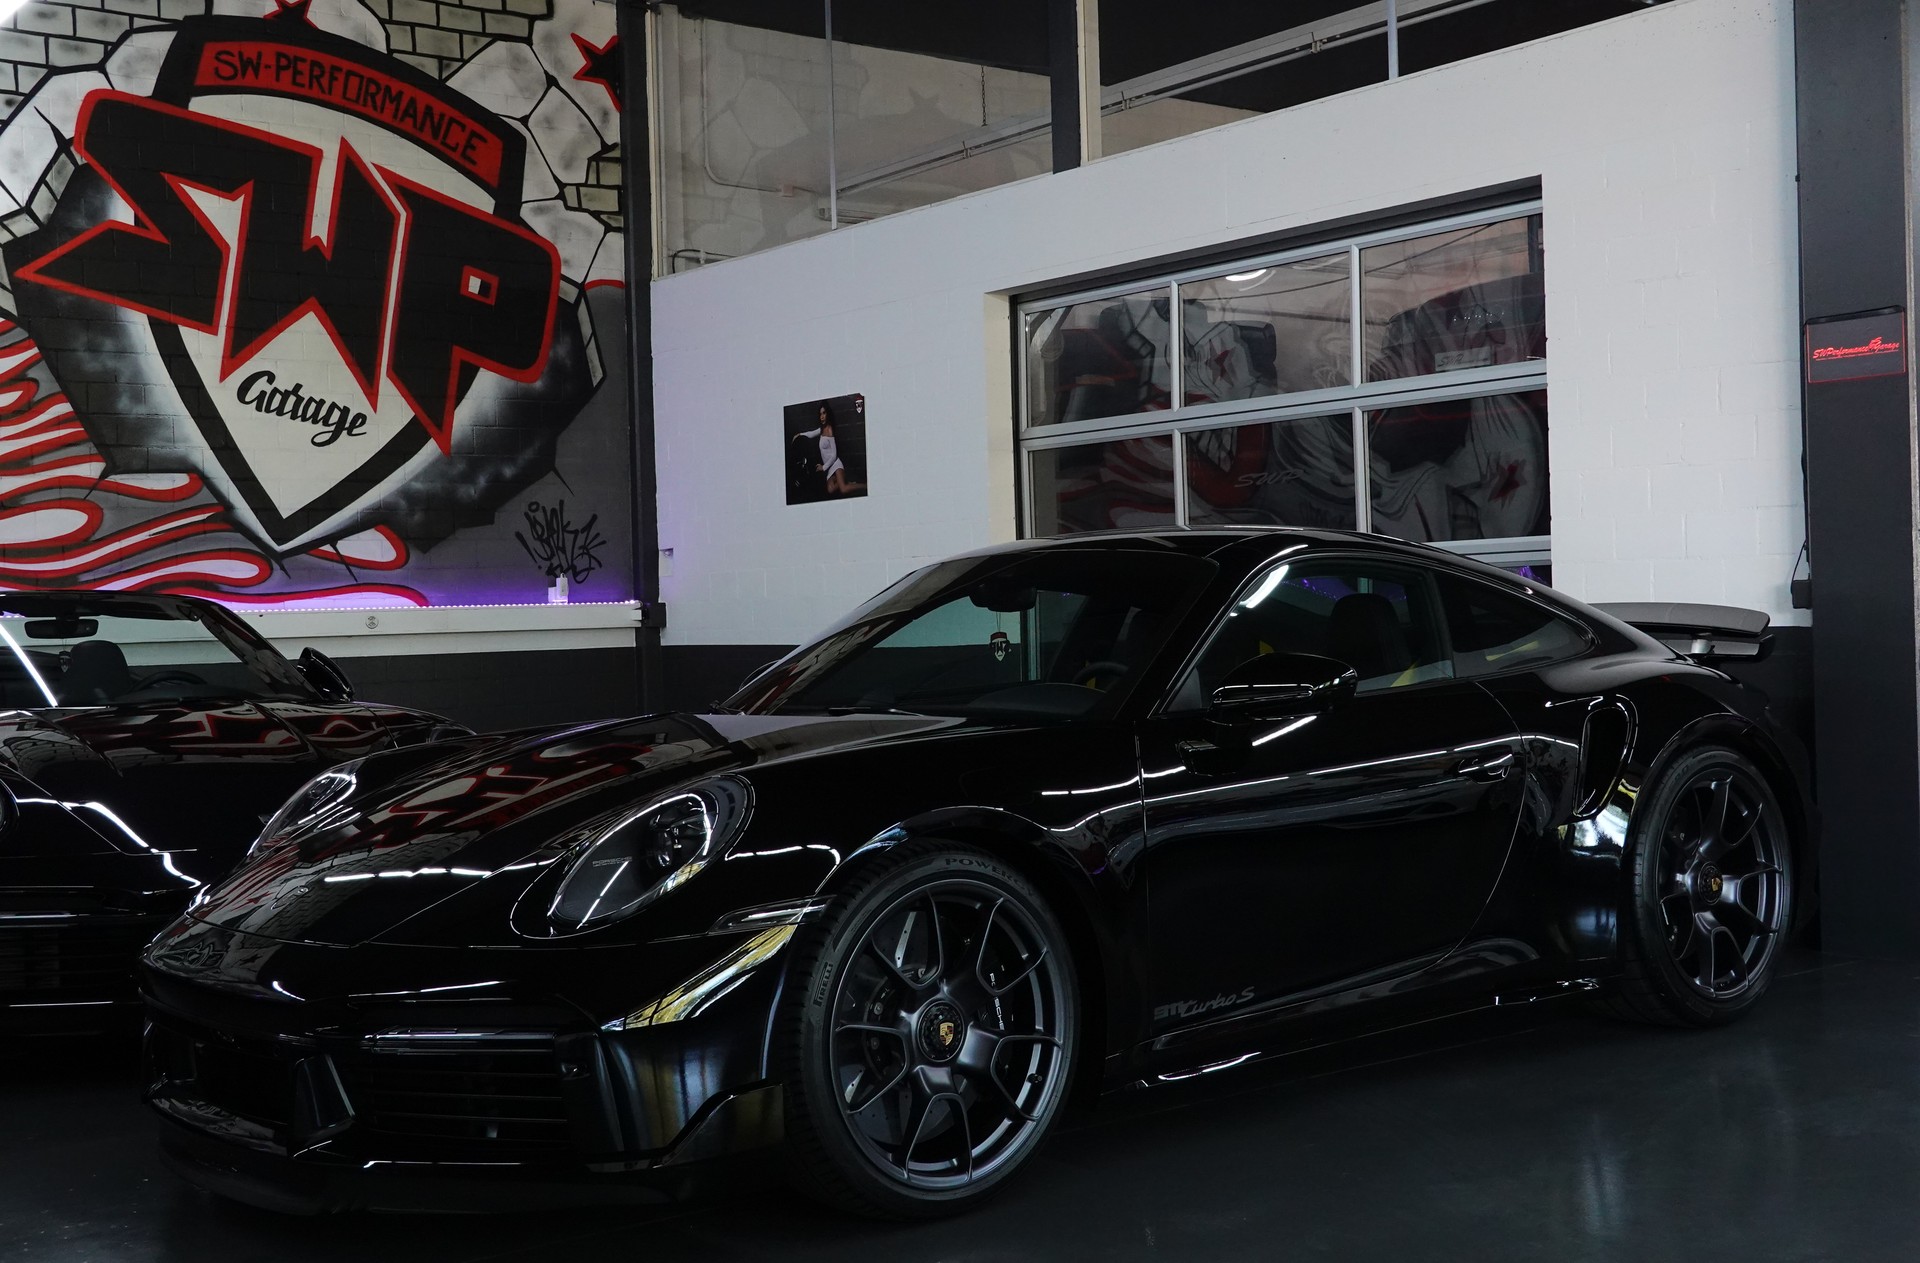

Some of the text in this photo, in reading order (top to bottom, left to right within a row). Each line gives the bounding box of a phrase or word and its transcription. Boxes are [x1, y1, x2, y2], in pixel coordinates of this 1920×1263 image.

[214, 50, 488, 167] SW-PERFORMANCE
[14, 88, 561, 457] SWP
[236, 370, 368, 447] Garage
